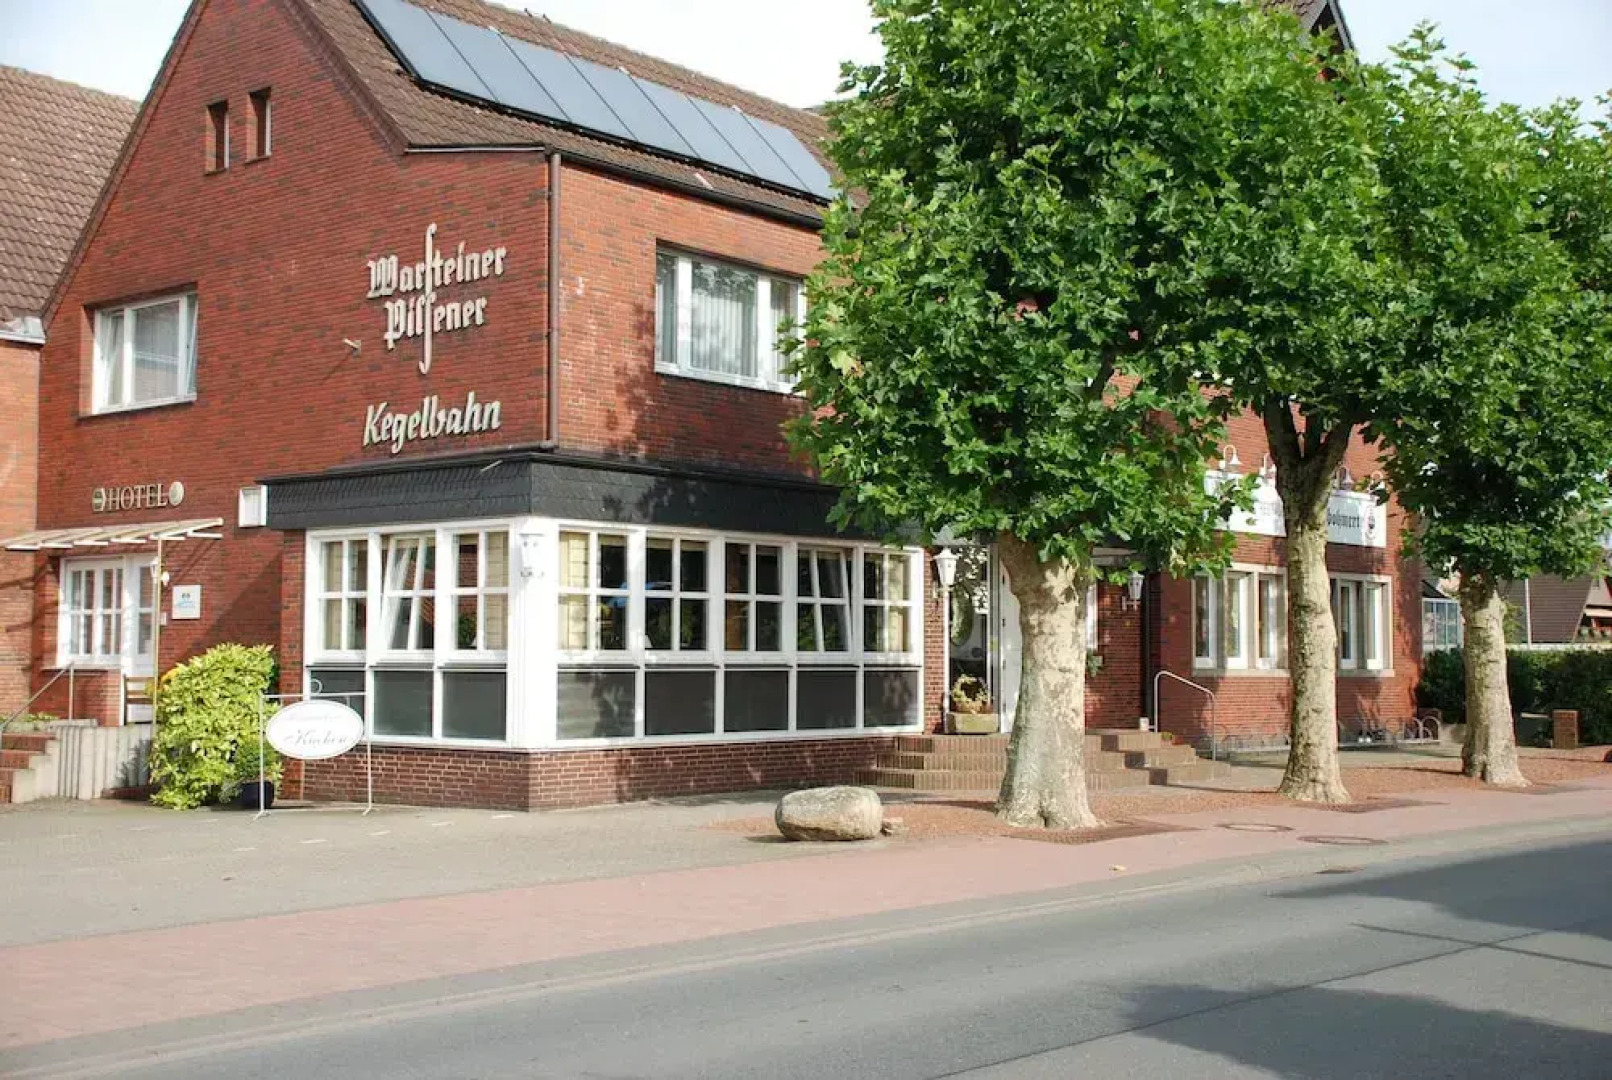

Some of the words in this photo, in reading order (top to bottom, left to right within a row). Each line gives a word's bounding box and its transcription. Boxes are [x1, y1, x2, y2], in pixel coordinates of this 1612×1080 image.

[366, 222, 507, 299] Warsteiner
[363, 390, 501, 454] Kegelbahn
[107, 483, 167, 510] HOTEL
